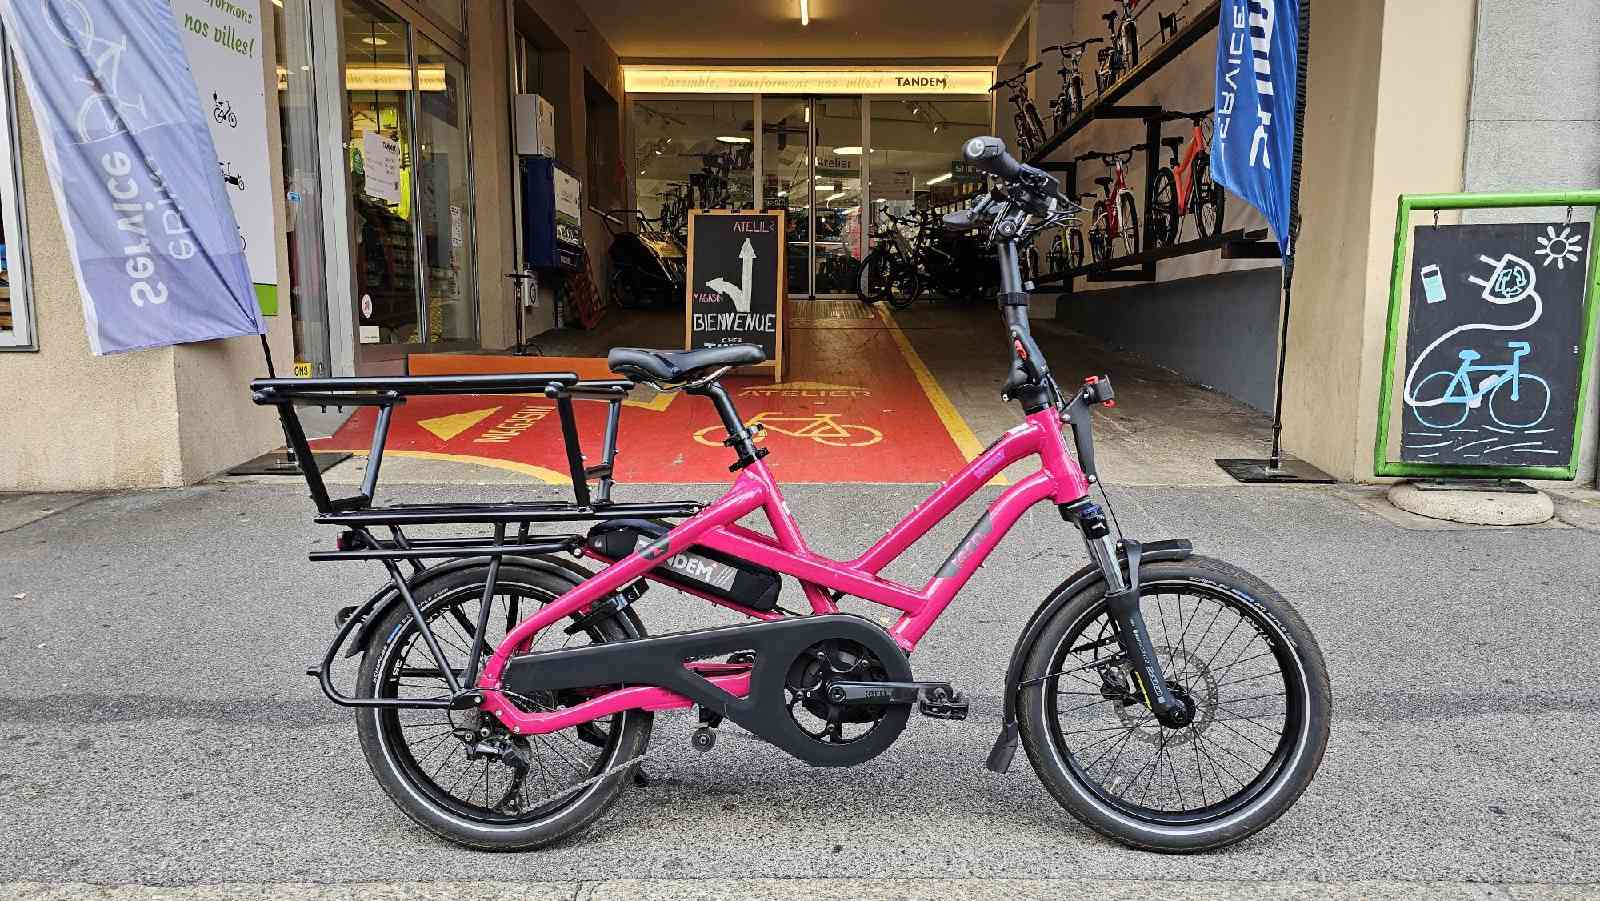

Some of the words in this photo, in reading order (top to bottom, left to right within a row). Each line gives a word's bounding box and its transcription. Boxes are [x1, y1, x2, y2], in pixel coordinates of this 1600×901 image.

[184, 13, 209, 38] nos
[214, 25, 255, 58] villes!
[895, 76, 948, 89] TANDEM
[693, 312, 776, 333] BIENVENUE
[737, 389, 874, 399] ATELIER
